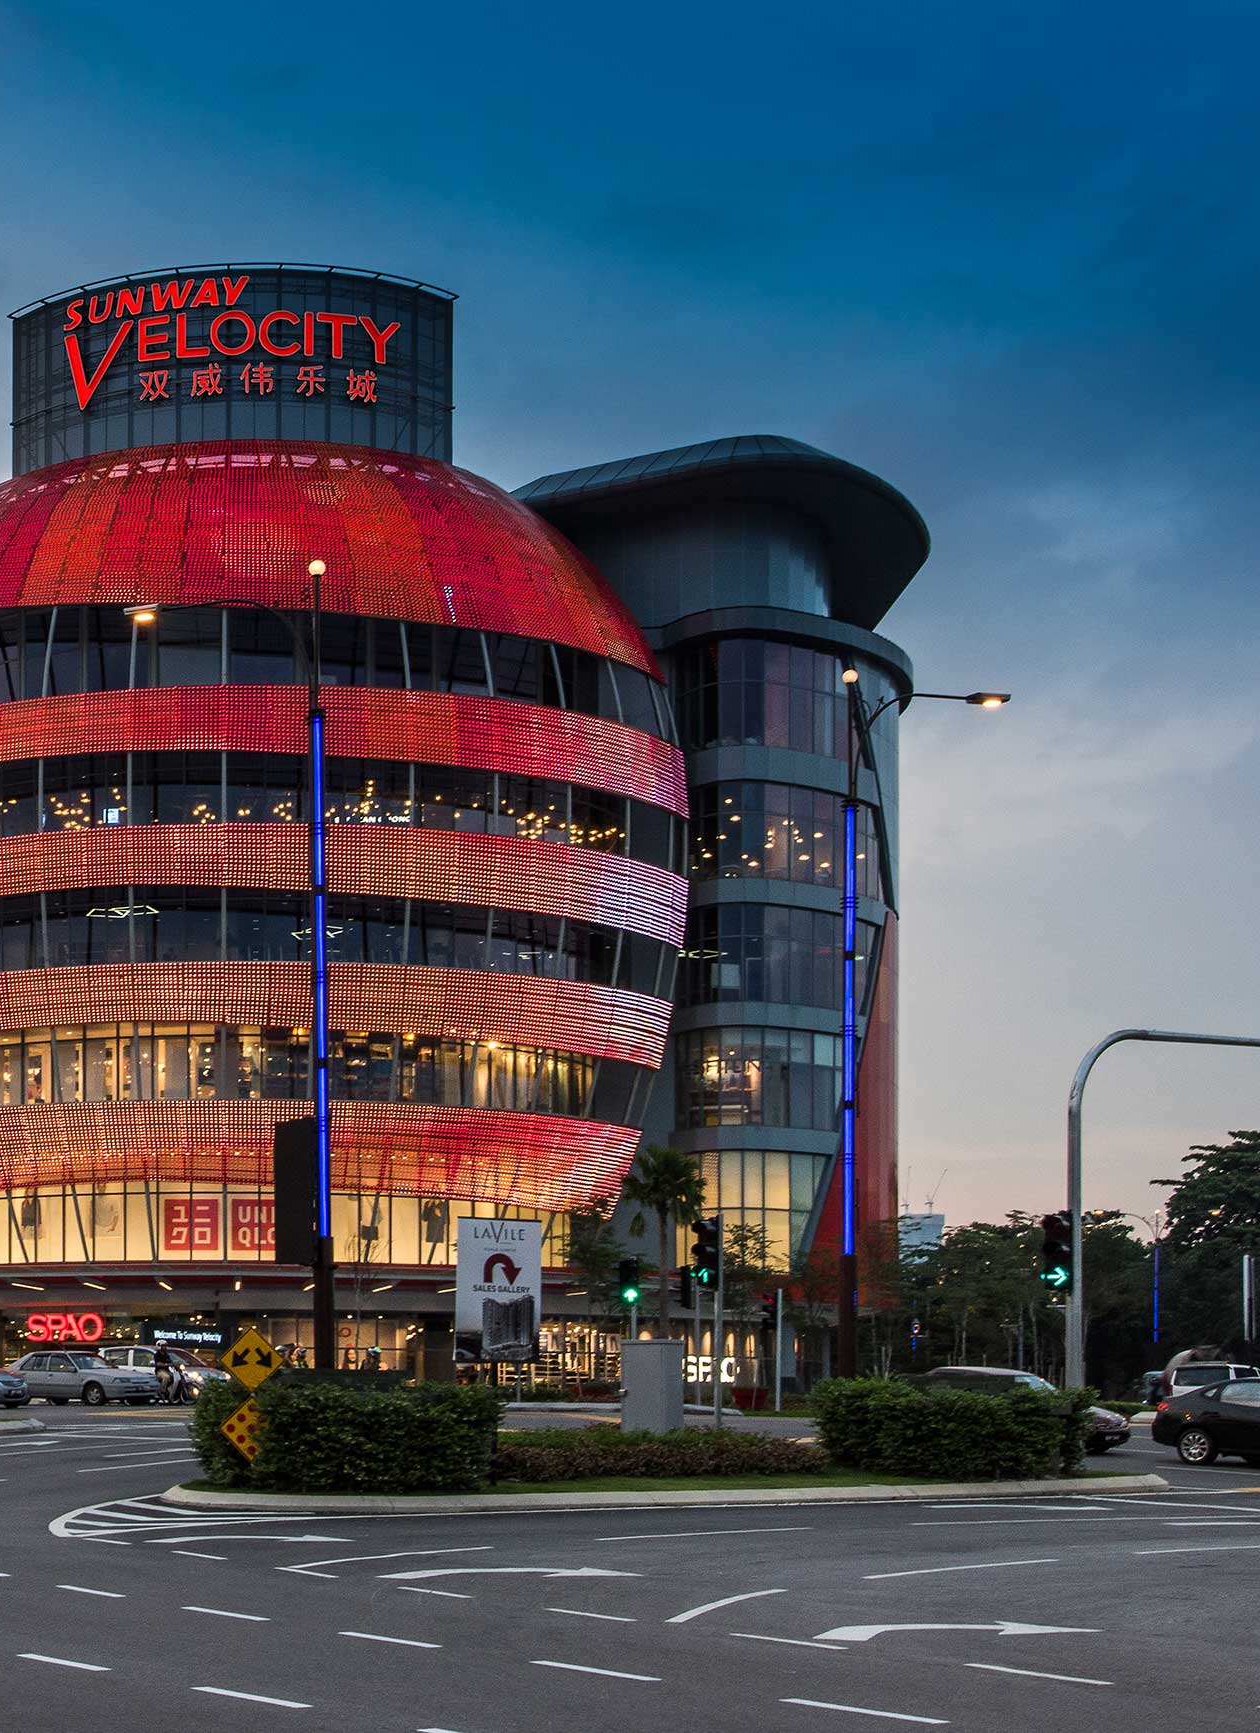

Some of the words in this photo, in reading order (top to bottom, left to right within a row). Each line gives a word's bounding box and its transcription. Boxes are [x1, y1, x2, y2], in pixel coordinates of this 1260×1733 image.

[63, 275, 249, 331] SUNWAY
[63, 309, 401, 411] VELOCITY
[138, 361, 378, 403] 双威伟乐城
[474, 1222, 525, 1243] LAVILE
[27, 1312, 104, 1342] SPAO
[154, 1330, 177, 1339] Welcome
[177, 1331, 183, 1339] To
[184, 1331, 202, 1343] Sunway
[203, 1333, 221, 1344] Velocity
